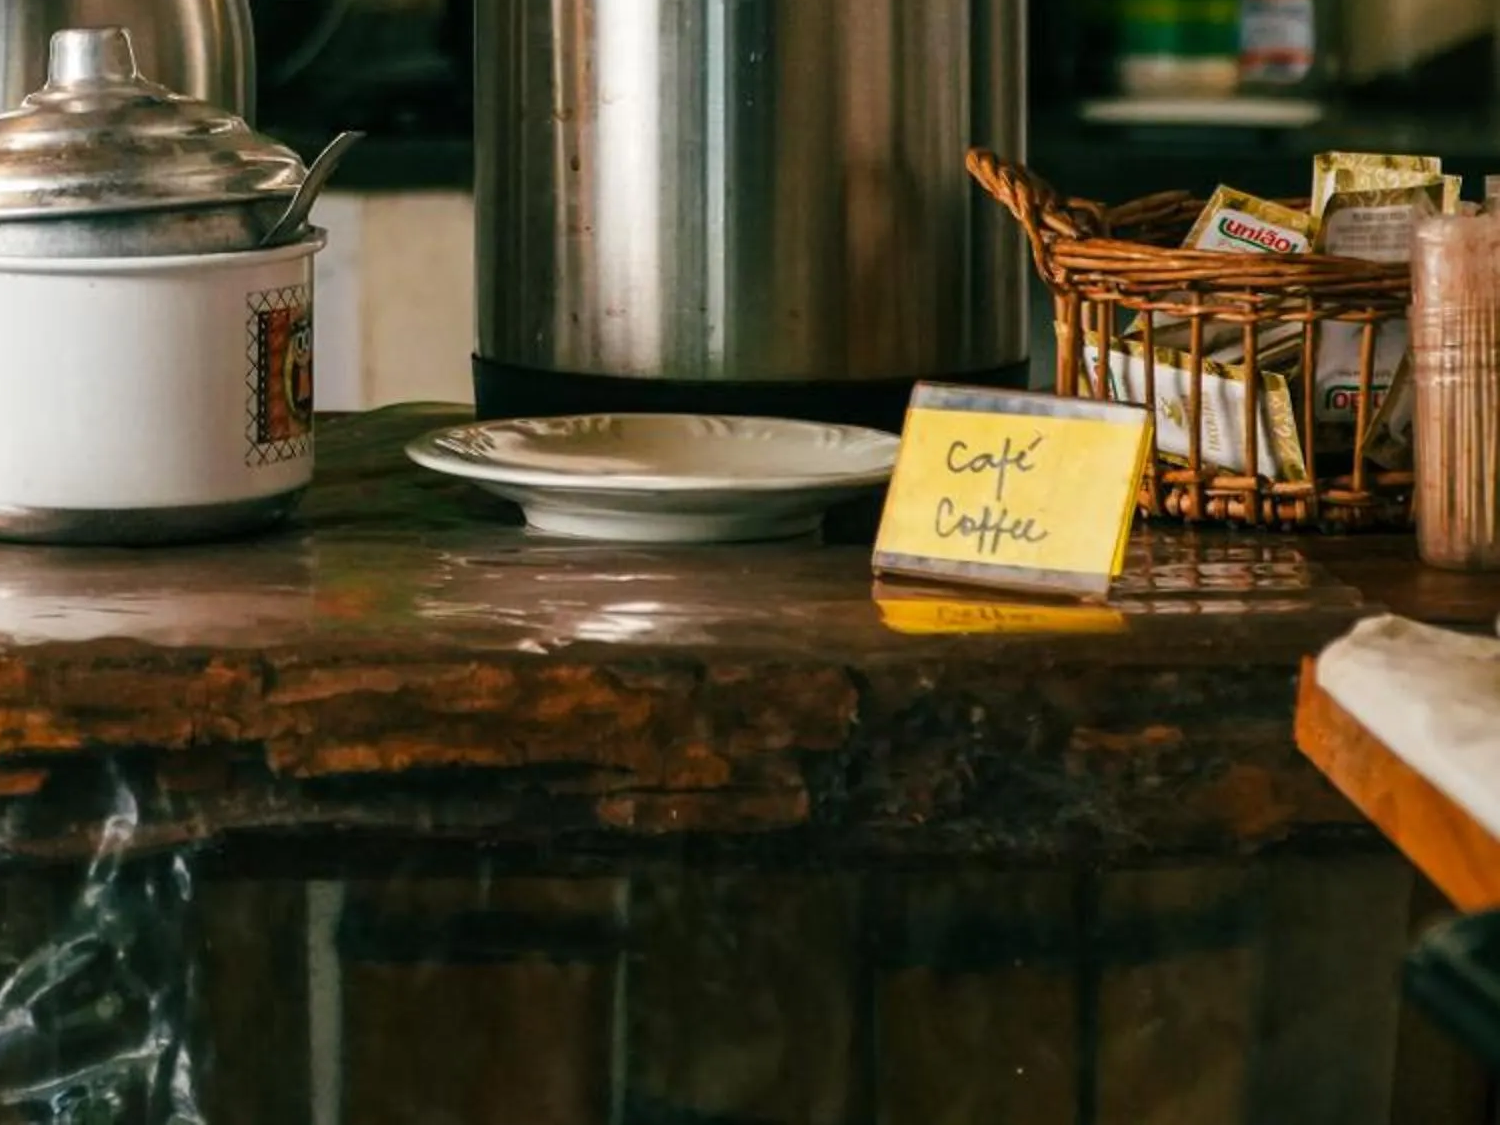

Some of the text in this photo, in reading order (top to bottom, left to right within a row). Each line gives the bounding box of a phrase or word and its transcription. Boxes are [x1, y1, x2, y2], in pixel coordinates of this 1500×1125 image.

[1222, 219, 1291, 253] união
[946, 436, 1043, 502] Café
[934, 496, 1050, 555] Coffee
